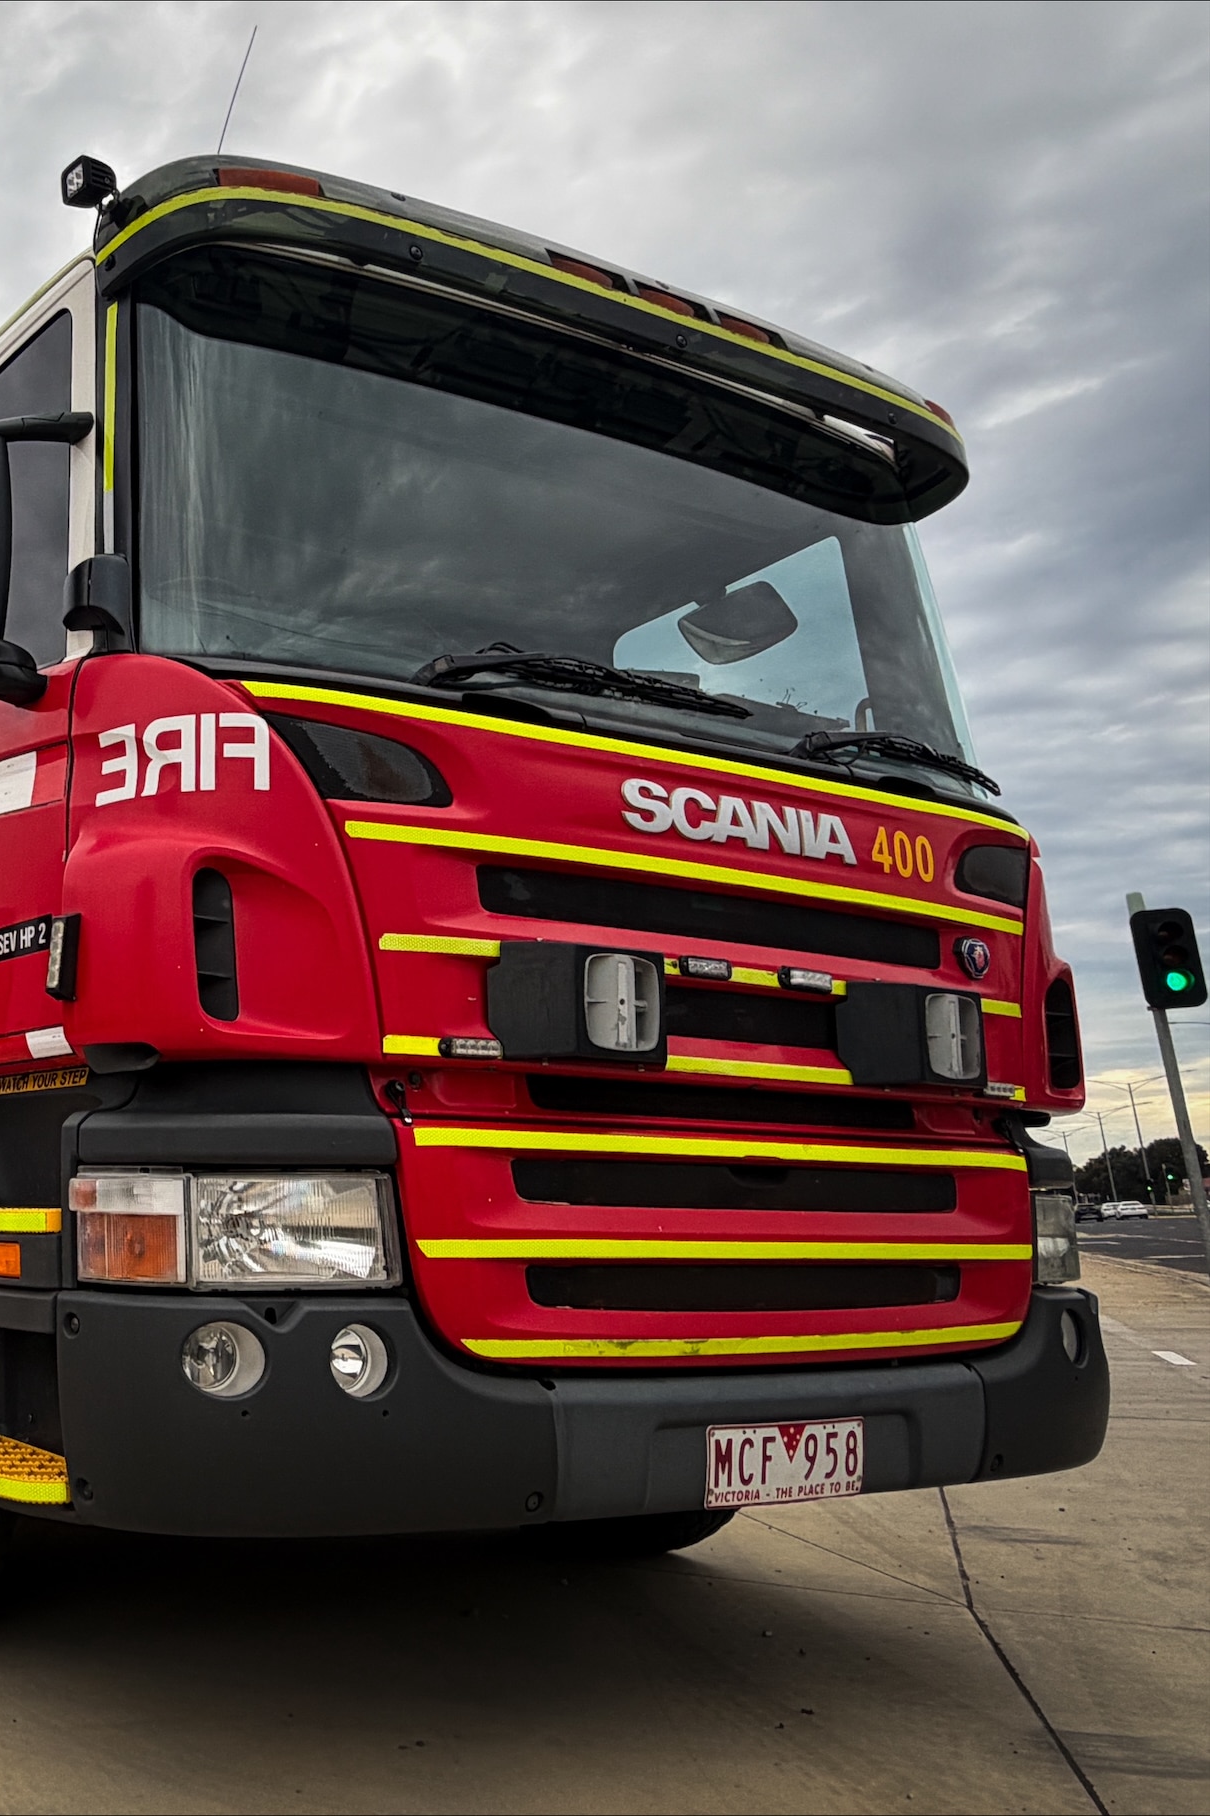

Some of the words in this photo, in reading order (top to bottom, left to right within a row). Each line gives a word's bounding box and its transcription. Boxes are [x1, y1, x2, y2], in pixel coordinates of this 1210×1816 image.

[621, 778, 858, 866] SCANIA
[871, 826, 935, 883] 400
[19, 925, 35, 950] HP
[38, 922, 46, 945] 2
[31, 1073, 60, 1090] YOUR
[60, 1069, 87, 1086] STEP
[714, 1436, 776, 1488] MCF
[804, 1430, 858, 1481] 958
[714, 1489, 760, 1503] VICTORIA
[776, 1486, 794, 1499] THE
[797, 1483, 825, 1497] PLACE
[829, 1481, 841, 1493] TO
